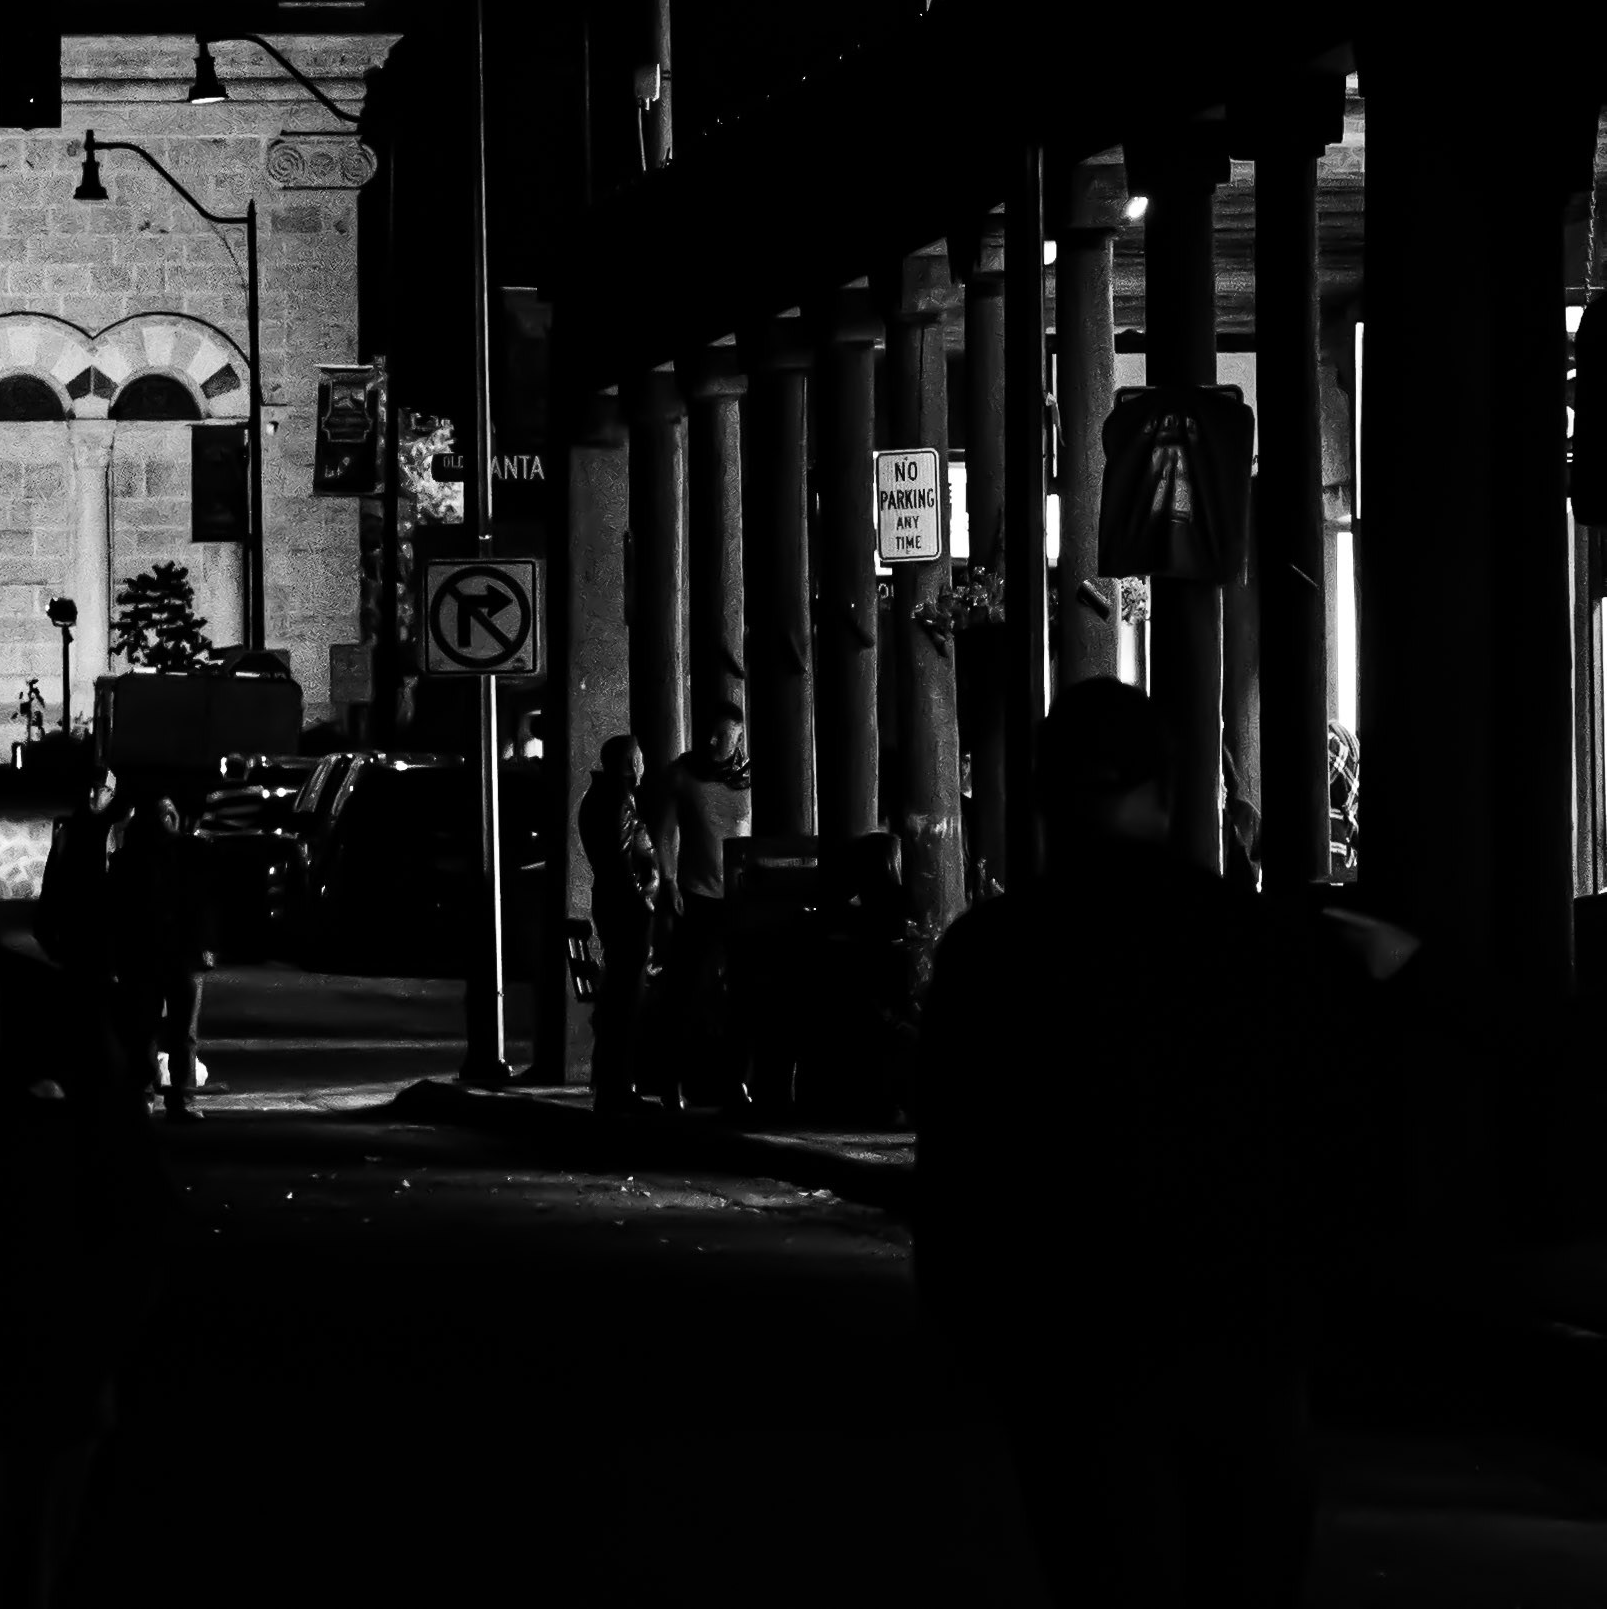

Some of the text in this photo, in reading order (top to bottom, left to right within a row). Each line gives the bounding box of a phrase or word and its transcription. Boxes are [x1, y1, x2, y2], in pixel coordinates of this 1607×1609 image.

[491, 455, 546, 480] ANTA
[894, 461, 918, 482] NO
[880, 488, 935, 511] PARKING
[896, 516, 920, 531] ANY
[895, 535, 922, 551] TIME
